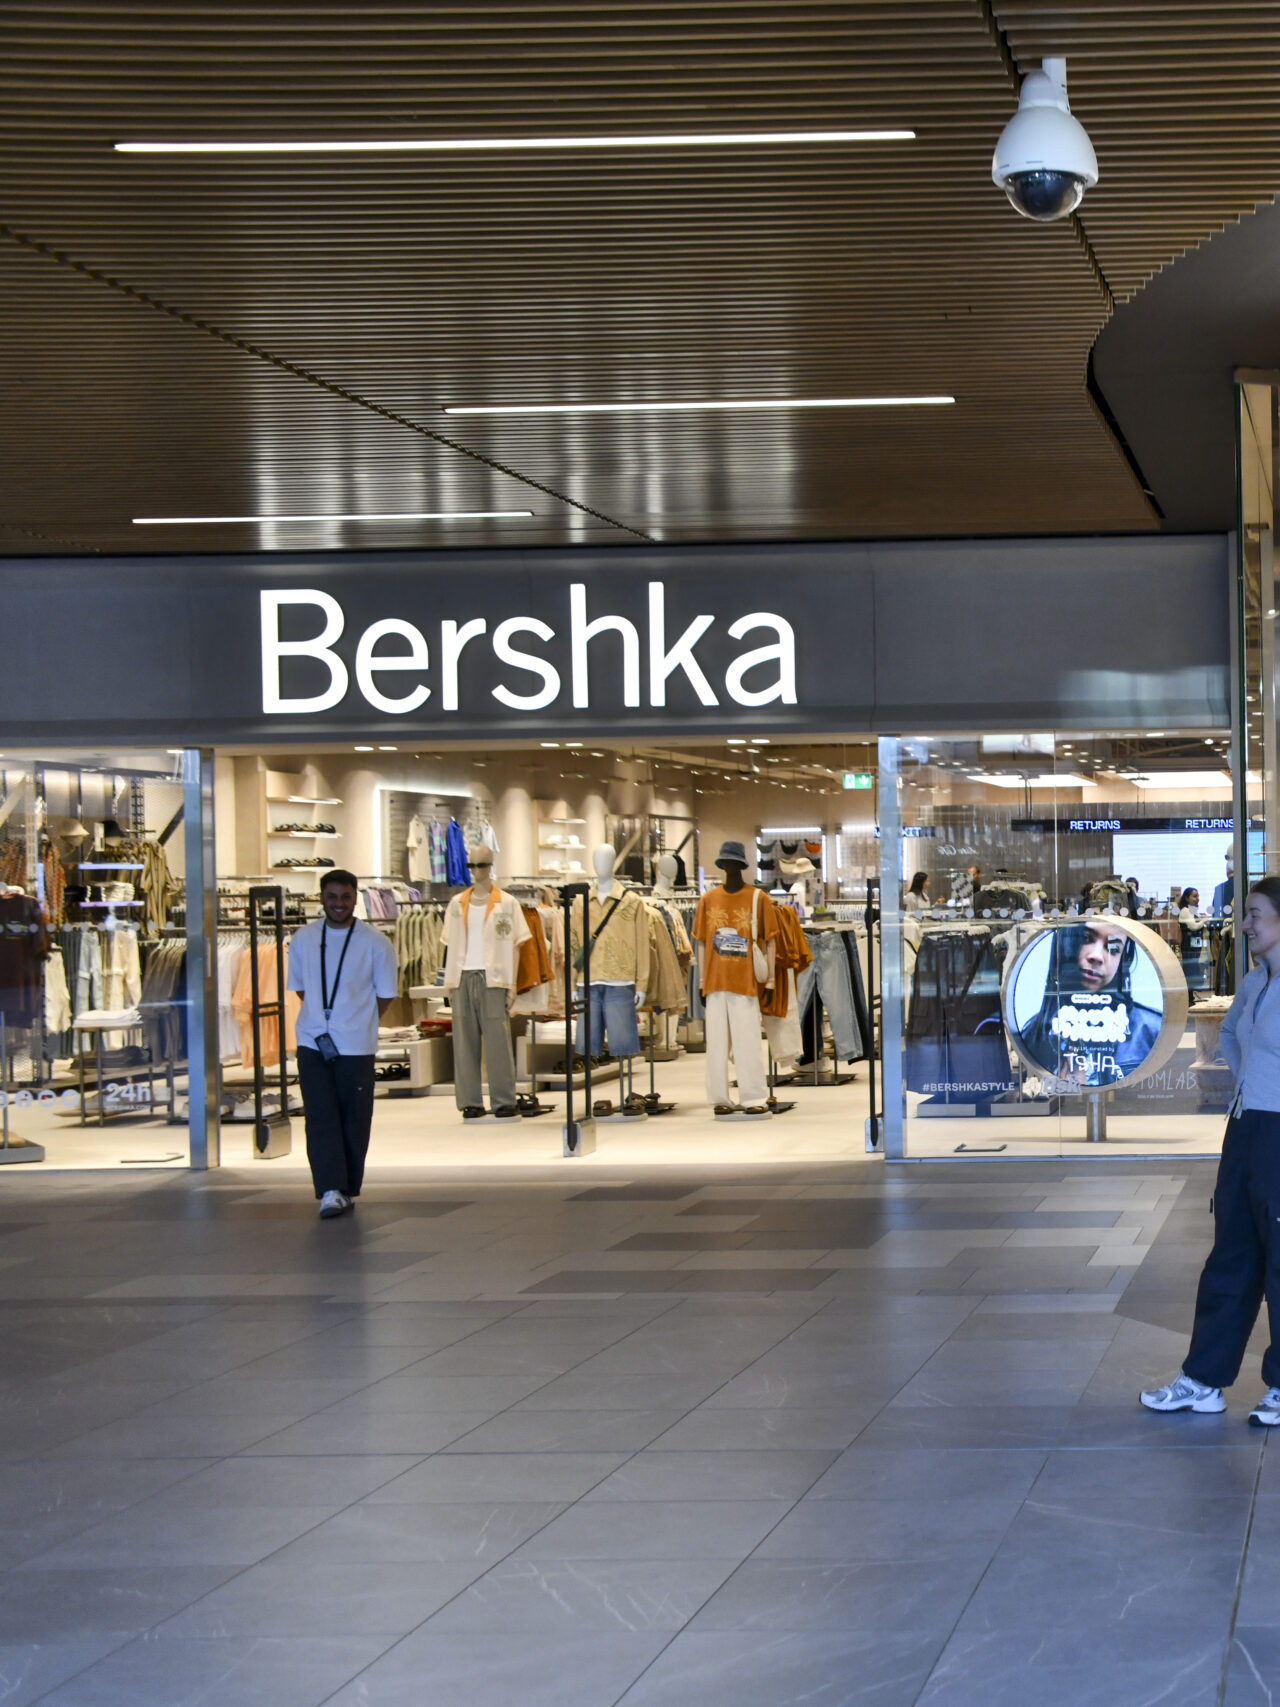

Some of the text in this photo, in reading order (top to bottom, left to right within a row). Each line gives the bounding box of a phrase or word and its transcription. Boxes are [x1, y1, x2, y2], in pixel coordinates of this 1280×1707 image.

[260, 581, 798, 714] Bershka
[1069, 819, 1121, 831] RETURNS
[1185, 818, 1235, 829] RETURNS
[105, 1082, 151, 1102] 24h
[922, 1082, 1015, 1092] #BERSHKASTYLE
